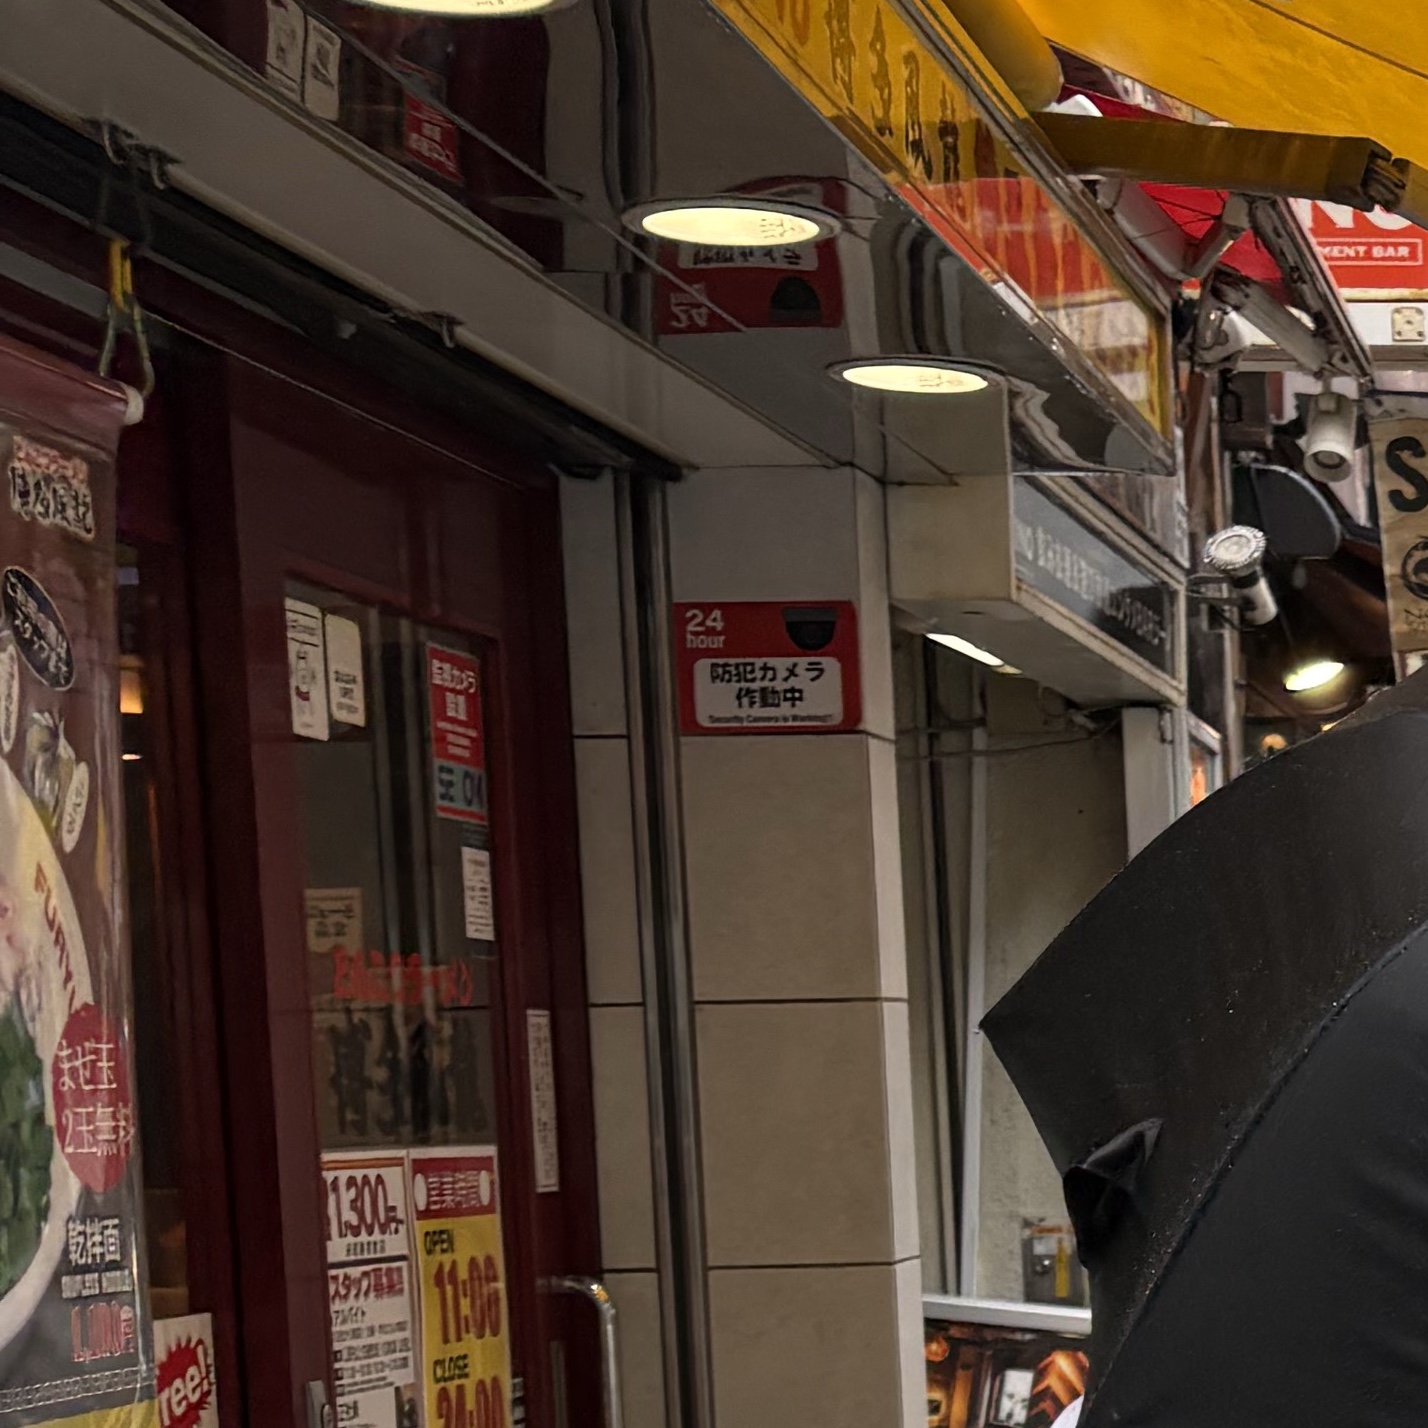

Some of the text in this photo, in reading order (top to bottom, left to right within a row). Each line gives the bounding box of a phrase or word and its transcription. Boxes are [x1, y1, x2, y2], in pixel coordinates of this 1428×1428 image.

[685, 609, 725, 632] 24
[686, 631, 726, 649] hour
[710, 661, 826, 685] 防犯カメラ
[735, 686, 805, 709] 作動中
